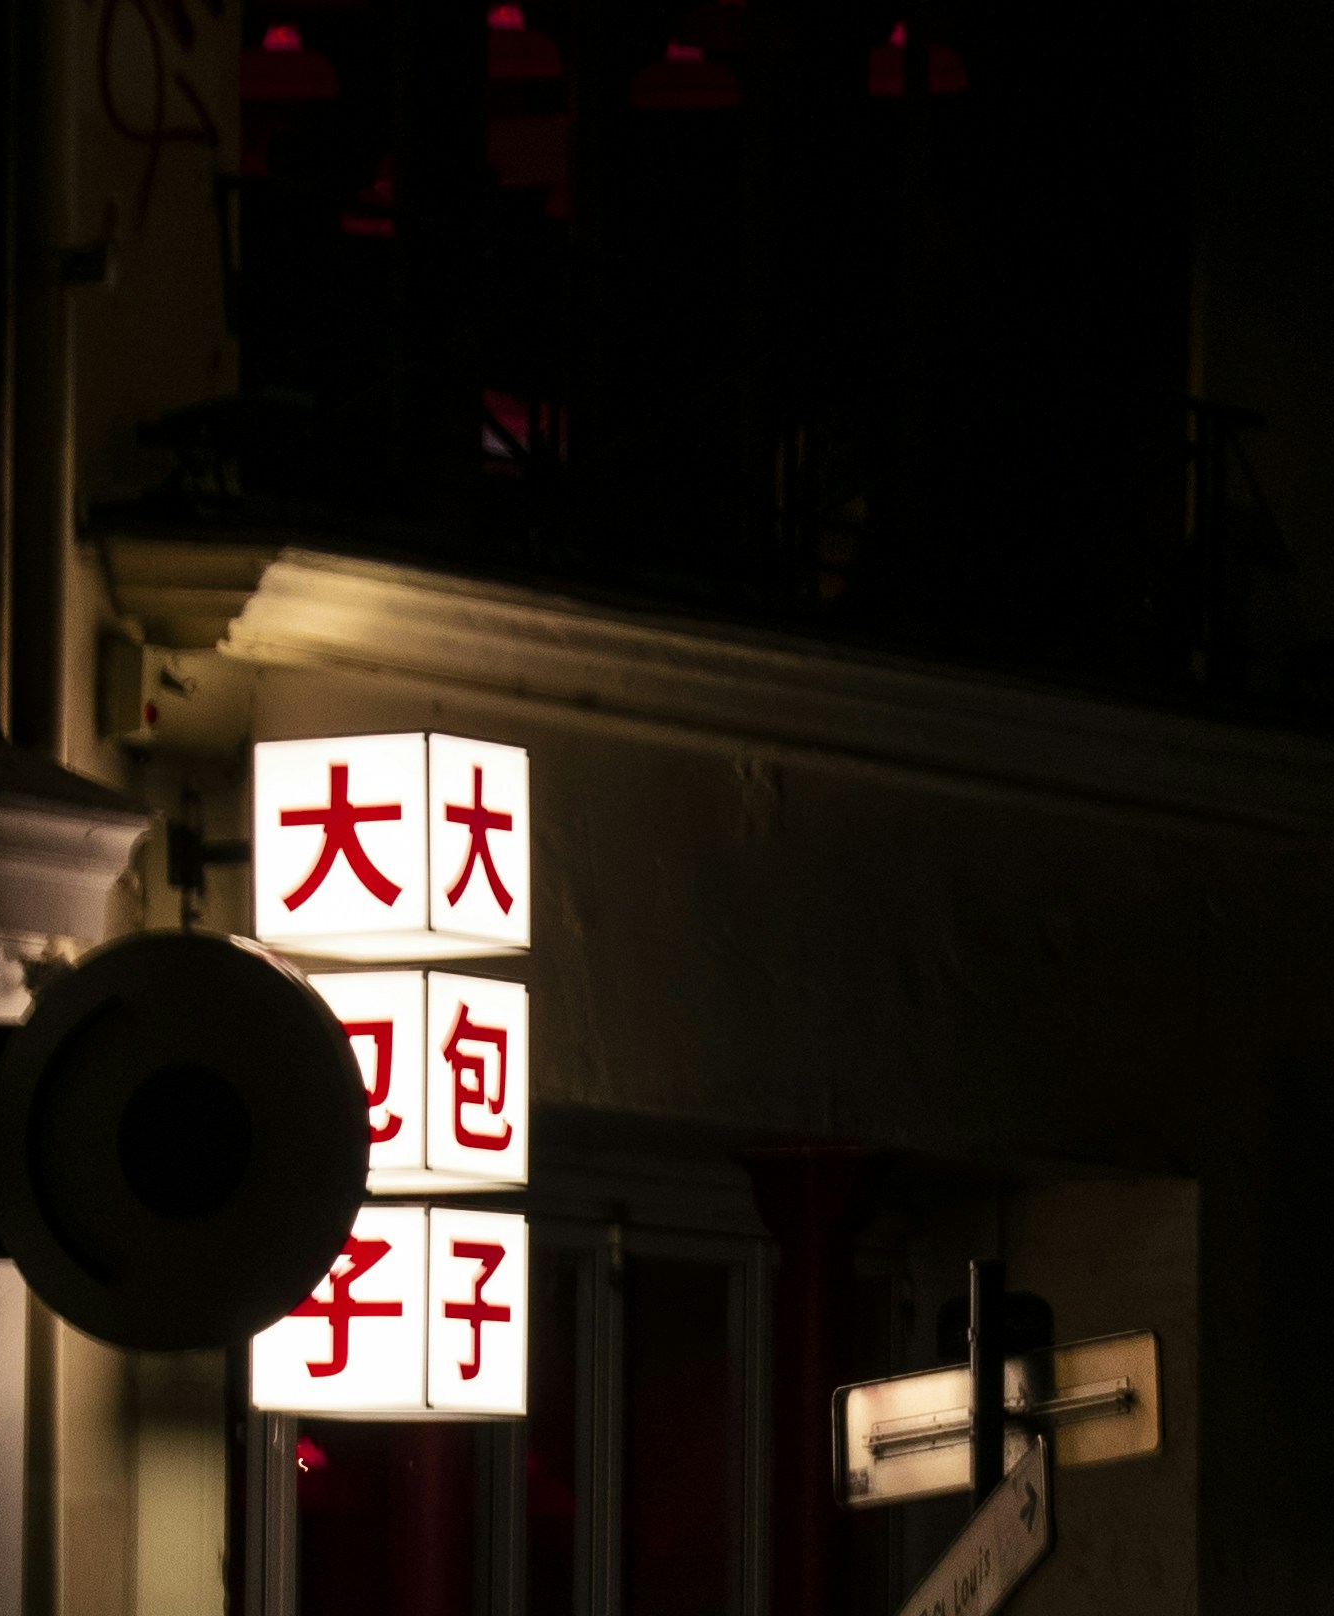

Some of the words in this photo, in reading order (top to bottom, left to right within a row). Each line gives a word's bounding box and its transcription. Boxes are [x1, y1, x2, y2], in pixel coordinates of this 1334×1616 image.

[444, 768, 513, 1380] 大包子
[954, 1548, 991, 1615] Louis
